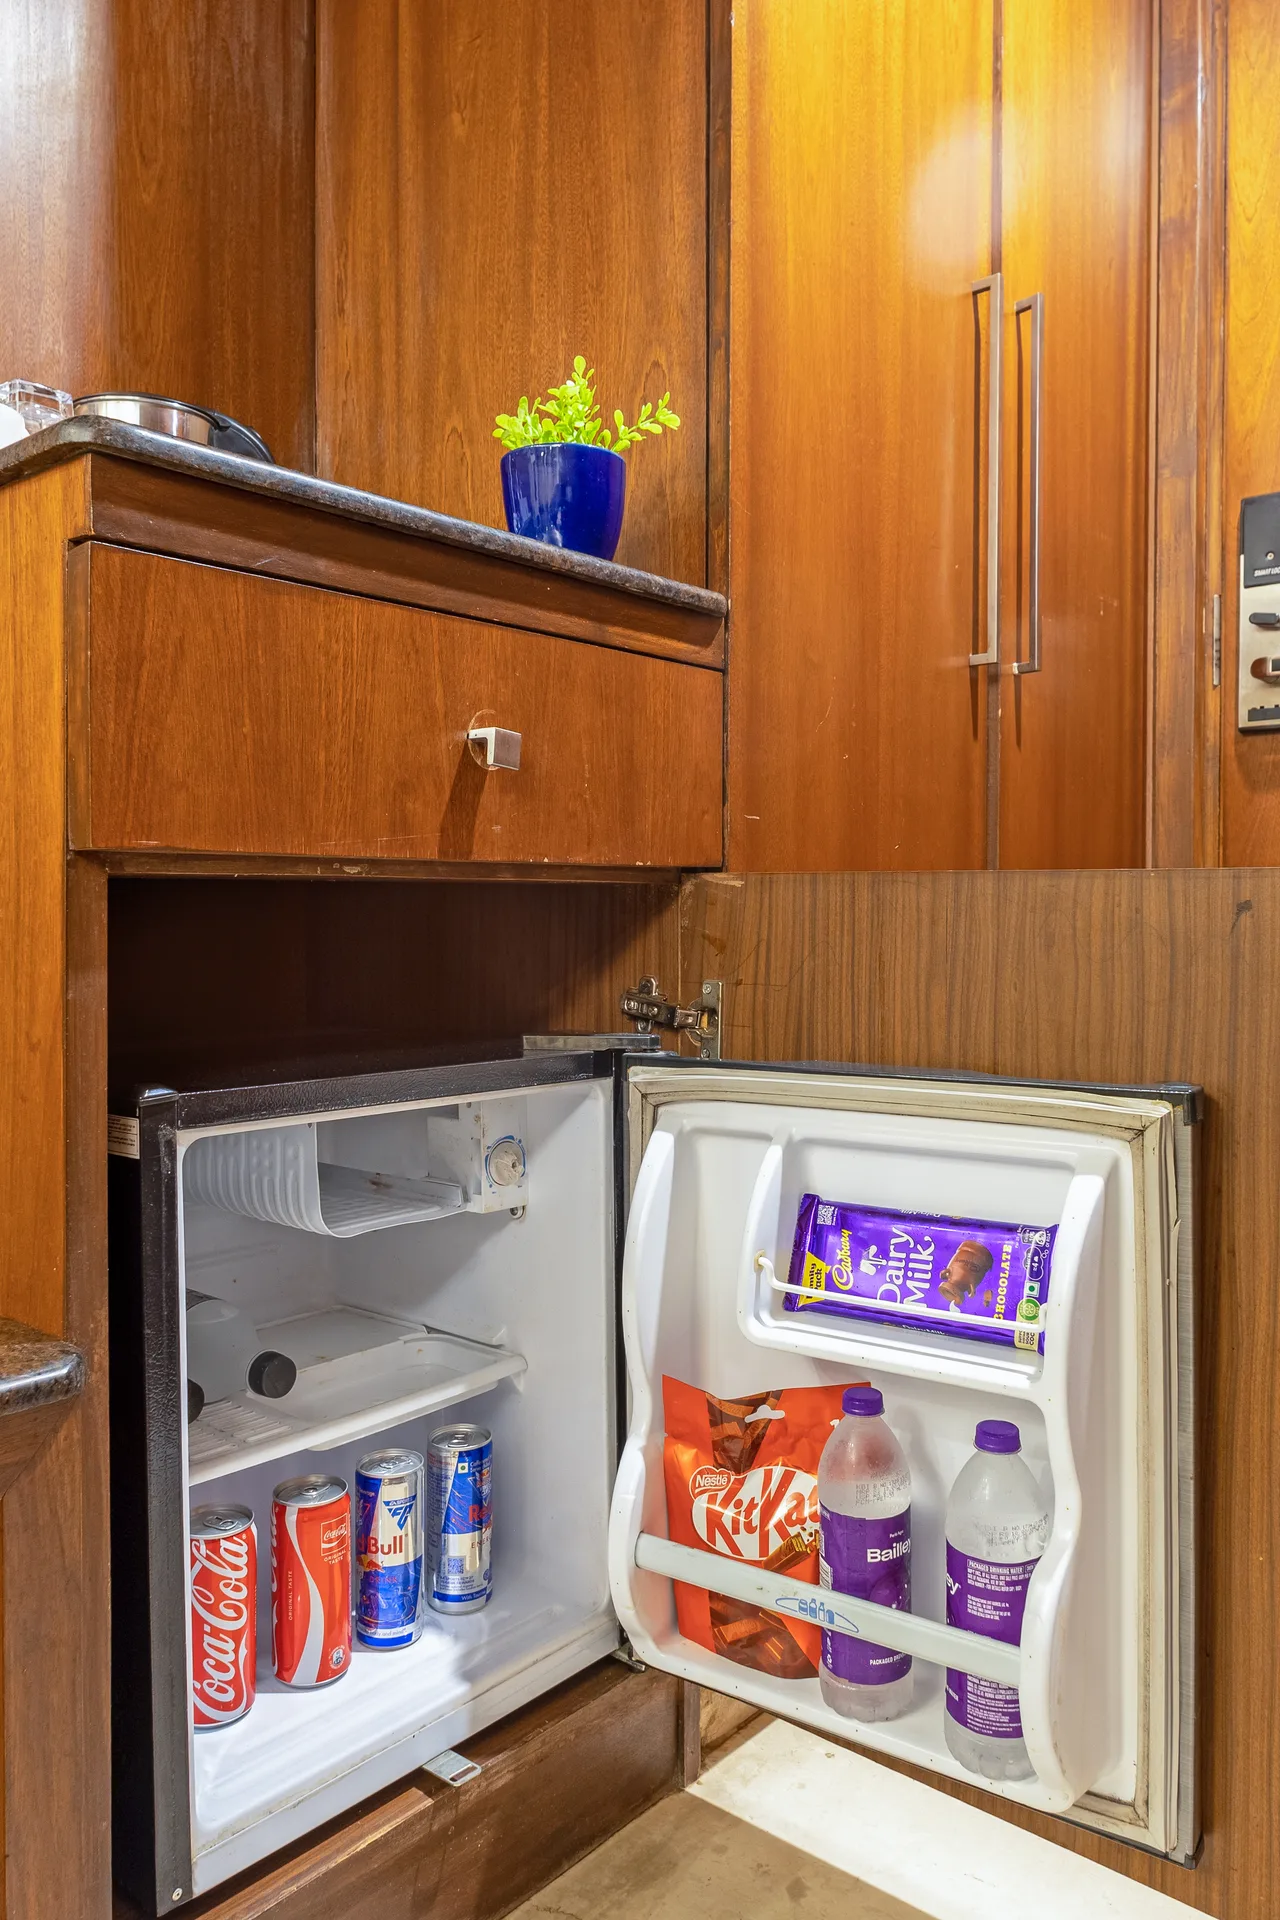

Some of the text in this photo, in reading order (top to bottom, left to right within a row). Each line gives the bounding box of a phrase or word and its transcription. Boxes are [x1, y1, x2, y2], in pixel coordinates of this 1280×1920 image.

[832, 1229, 853, 1291] Cadbury
[877, 1227, 915, 1304] Dairy
[903, 1235, 935, 1309] Milk
[323, 1523, 347, 1541] Coca-Cola
[323, 1549, 347, 1562] ORIGINAL
[367, 1534, 404, 1556] Bull
[328, 1555, 344, 1565] TASTE
[191, 1535, 249, 1722] Coca-Cola
[870, 1656, 893, 1666] PACKAGED
